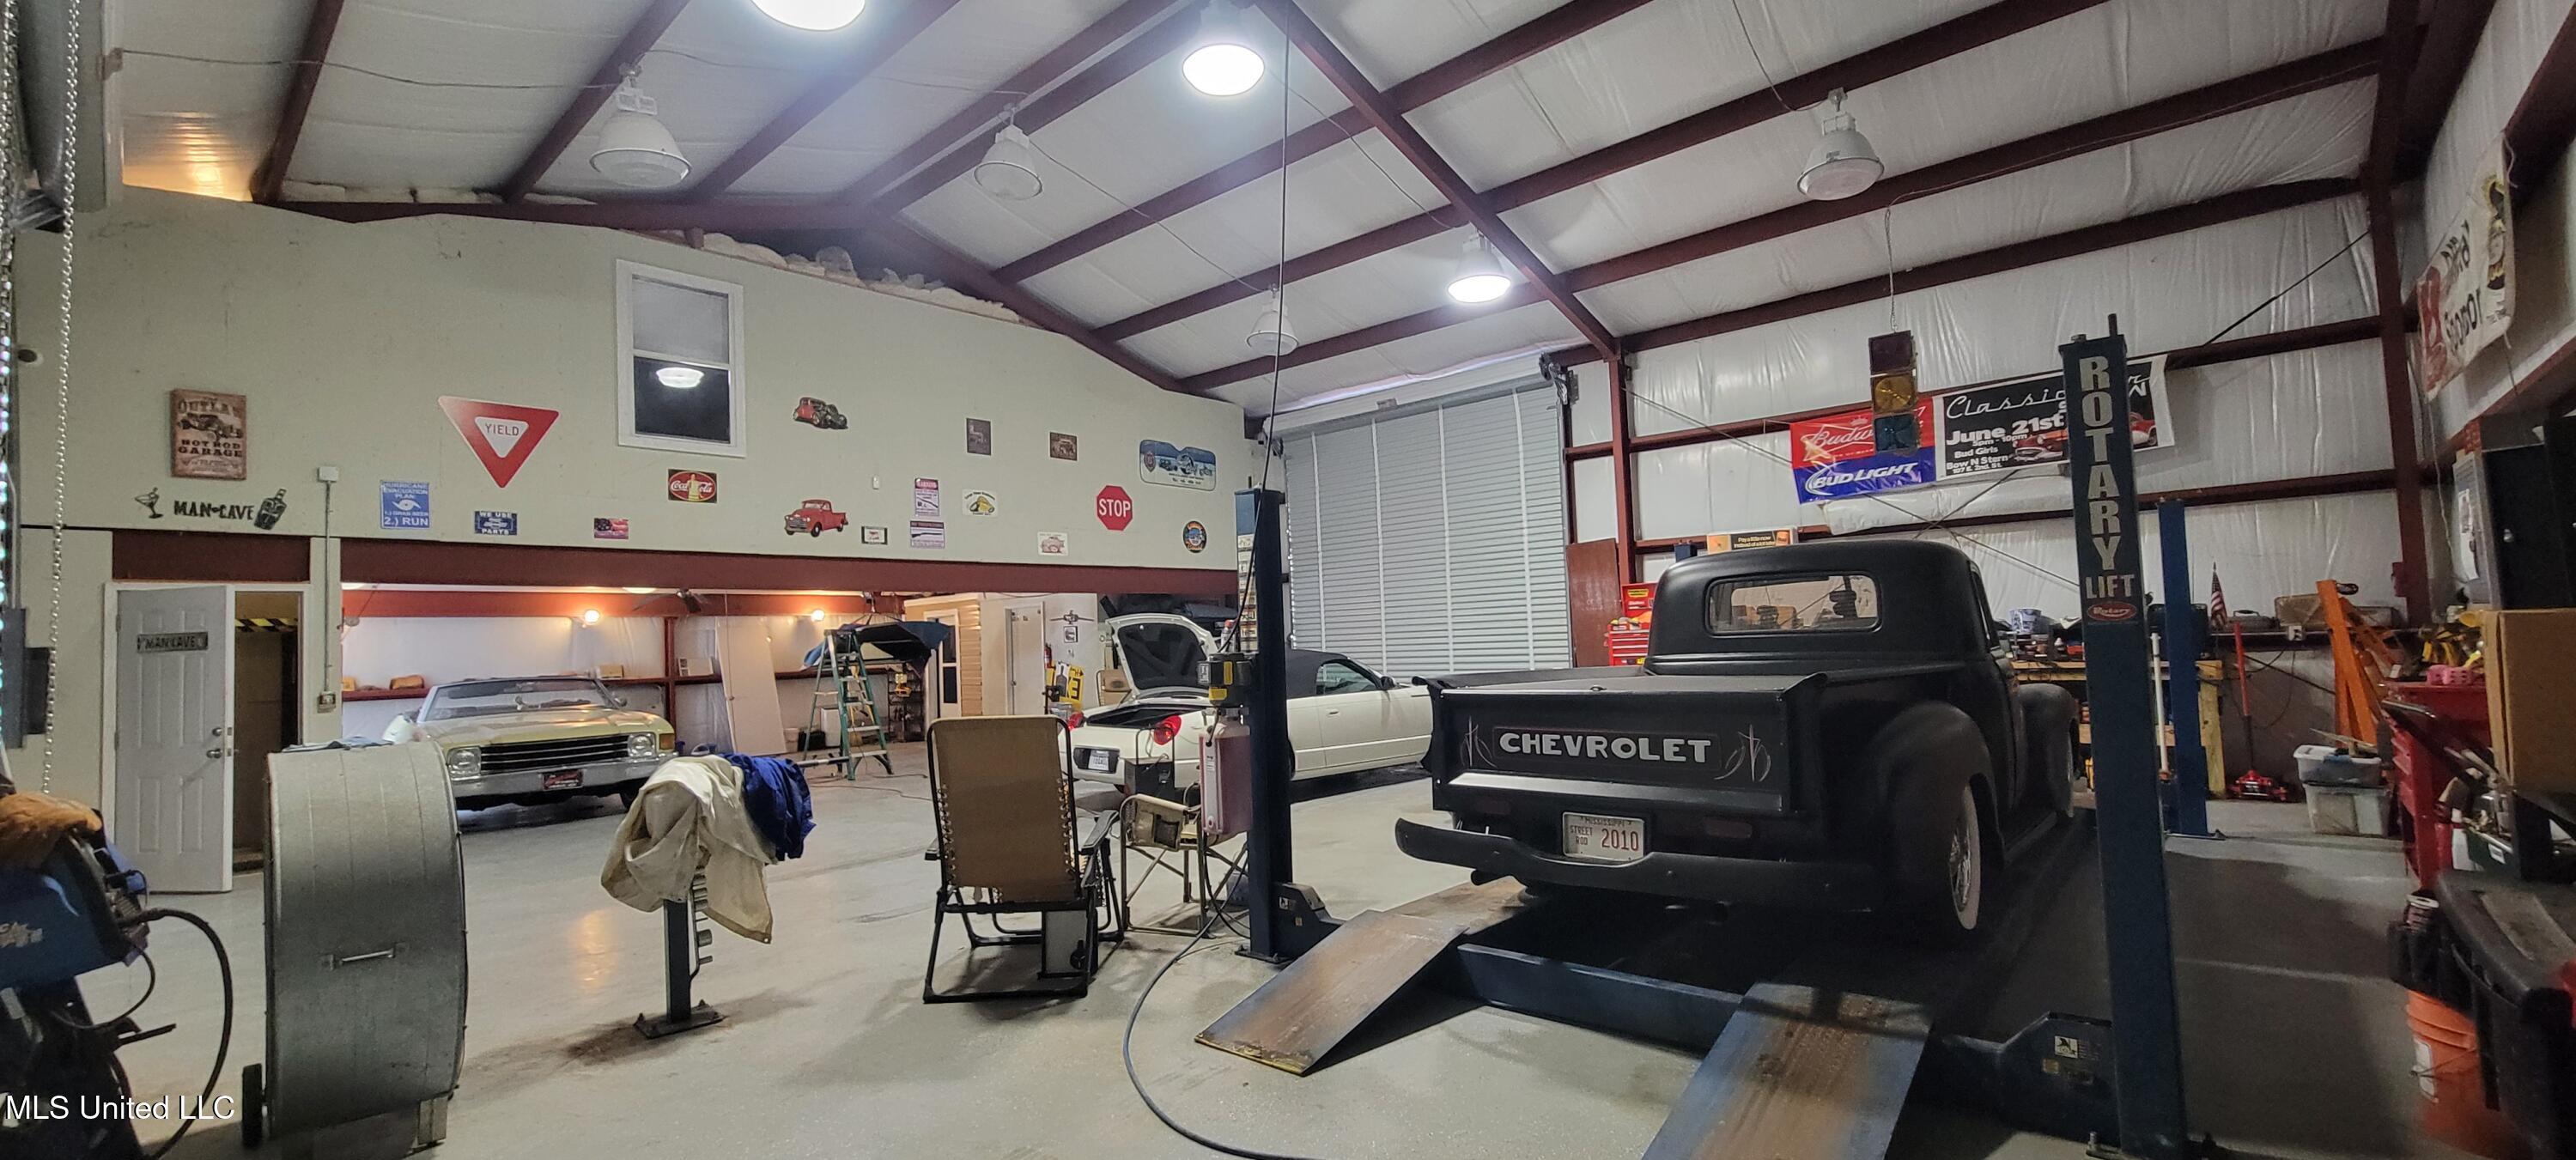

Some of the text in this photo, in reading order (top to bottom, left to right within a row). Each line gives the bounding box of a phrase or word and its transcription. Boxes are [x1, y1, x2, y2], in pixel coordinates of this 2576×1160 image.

[485, 422, 520, 436] YIELD
[1947, 412, 2065, 446] June 21st
[181, 439, 240, 449] HOT ROD
[178, 446, 243, 458] GARAGE
[1954, 446, 1999, 459] Bud Girls
[1946, 455, 2009, 470] Bow N Stern
[2078, 355, 2122, 571] ROTARY
[1813, 462, 1919, 489] BUD LIGHT
[1098, 498, 1132, 518] STOP
[384, 516, 429, 527] 2.) RUN
[2086, 574, 2135, 599] LIFT
[1499, 732, 1711, 763] CHEVROLET
[1570, 825, 1593, 836] STREET
[1575, 836, 1589, 845] ROD
[1601, 828, 1639, 852] 2010
